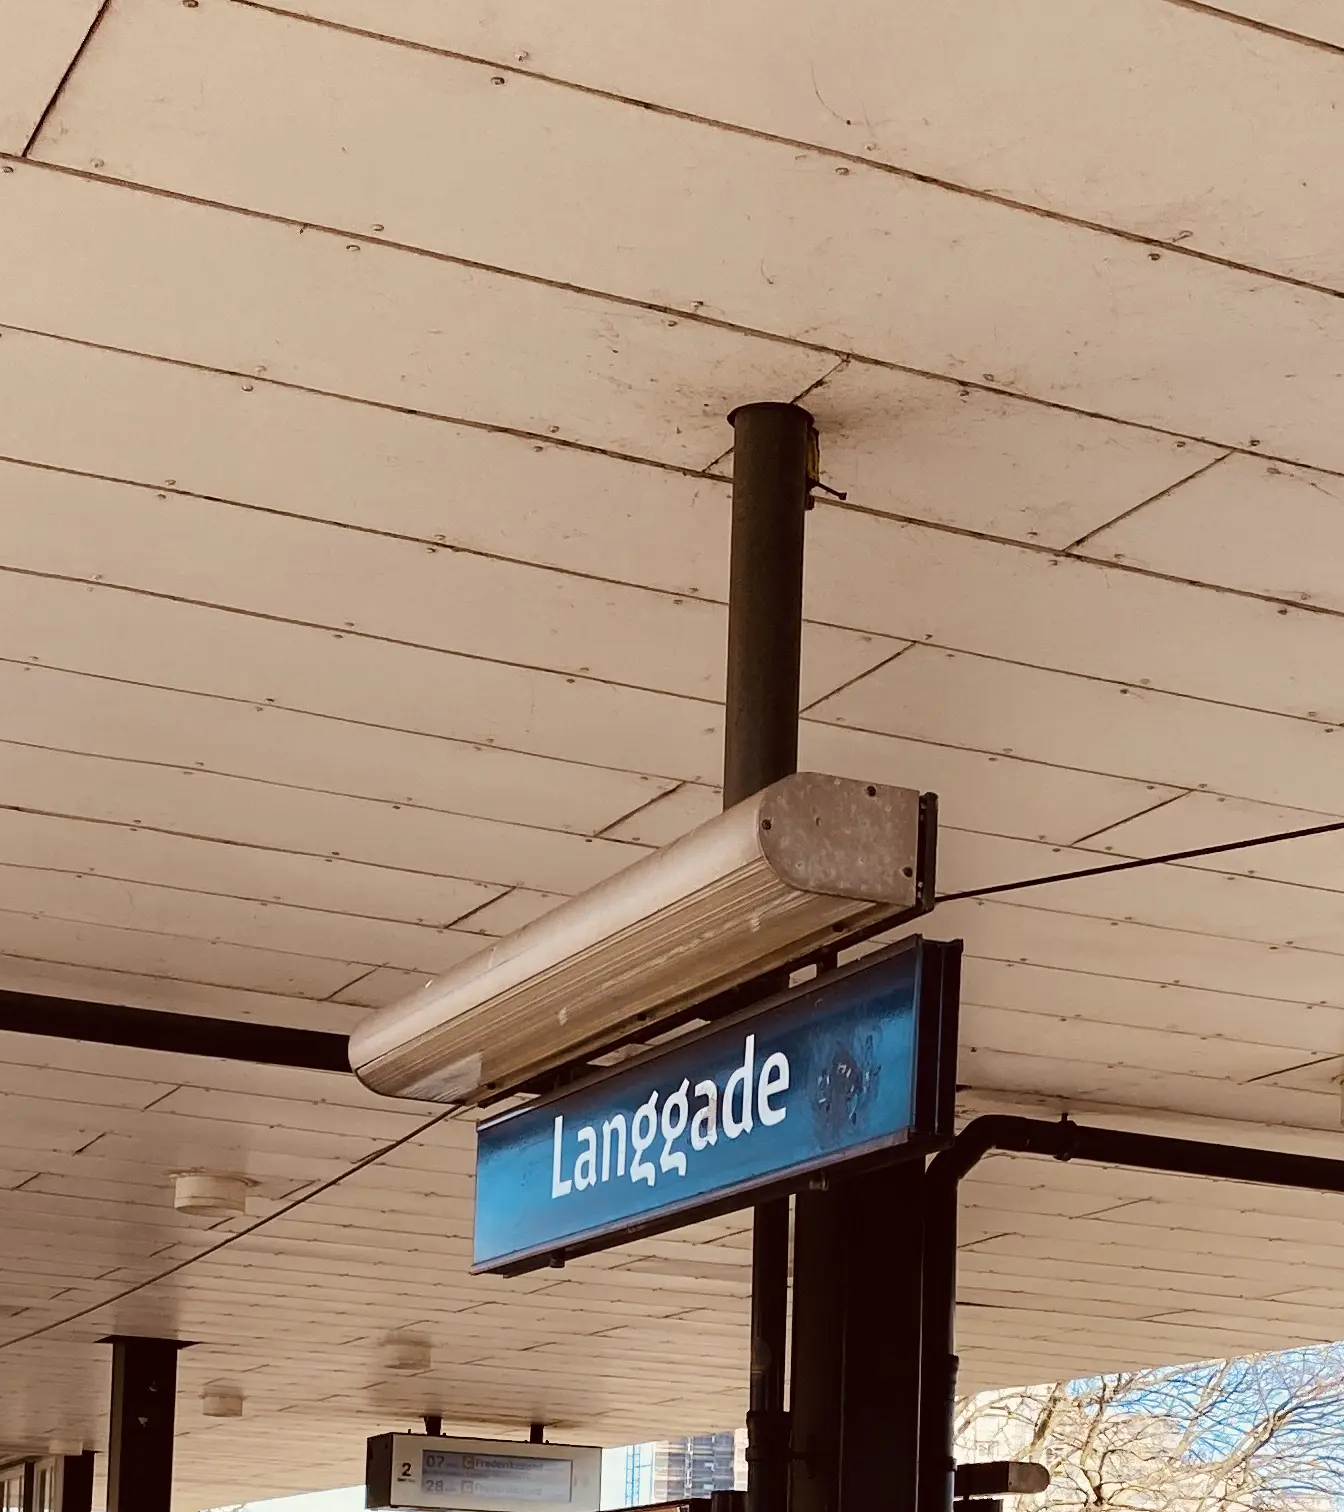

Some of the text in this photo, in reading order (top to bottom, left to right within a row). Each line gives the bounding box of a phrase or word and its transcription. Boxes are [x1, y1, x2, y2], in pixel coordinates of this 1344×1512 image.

[552, 1034, 790, 1200] Langgade
[426, 1454, 445, 1468] 07
[401, 1462, 412, 1477] 2
